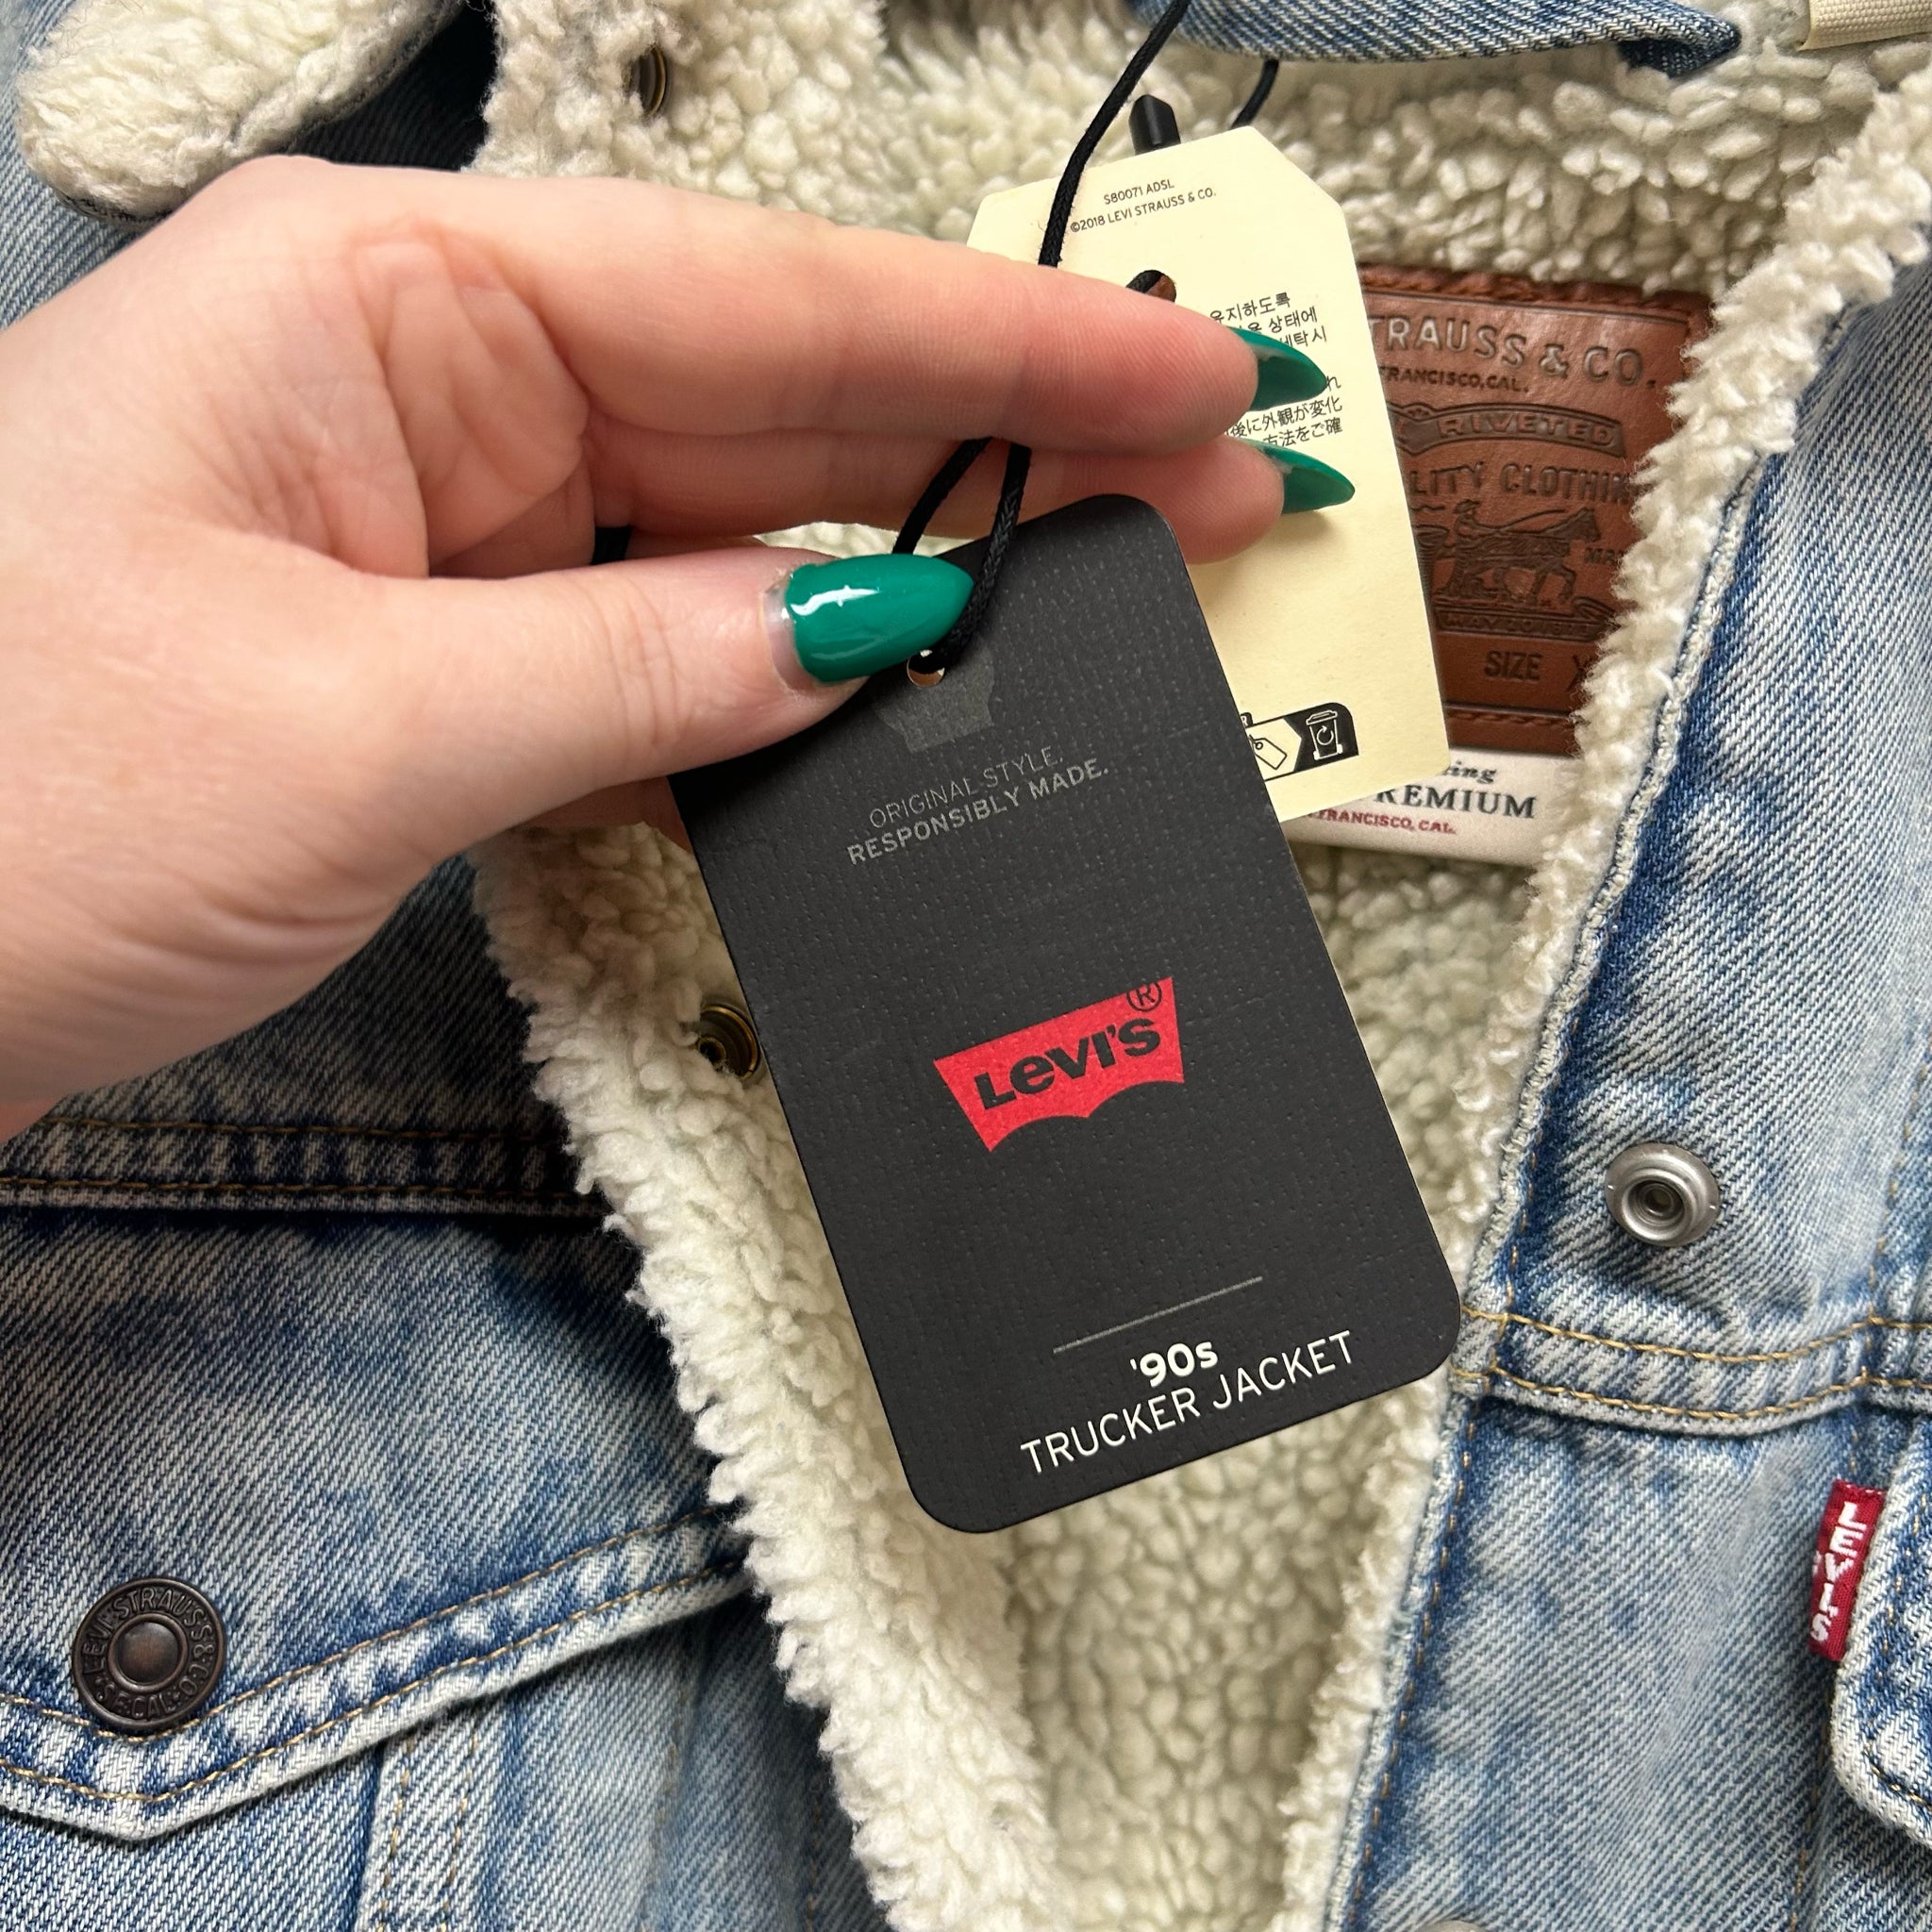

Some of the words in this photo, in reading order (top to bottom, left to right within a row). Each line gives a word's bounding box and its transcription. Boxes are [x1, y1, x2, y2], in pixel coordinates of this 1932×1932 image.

[1104, 186, 1143, 205] S80071
[1146, 178, 1174, 195] ADSL
[1108, 208, 1133, 224] LEVI
[1135, 194, 1185, 216] STRAUSS
[1188, 192, 1195, 203] &
[1197, 187, 1217, 200] CO.
[1269, 306, 1318, 333] 상태에
[1367, 313, 1527, 369] TRAUSS
[1539, 343, 1569, 379] &
[1584, 345, 1656, 391] CO.
[1226, 396, 1342, 438] 後に外観が変化
[1437, 411, 1617, 446] RIVETED
[1500, 460, 1630, 504] CLOTHIN
[1484, 650, 1544, 681] SIZE
[869, 777, 979, 828] ORIGINAL
[982, 746, 1064, 789] STYLE.
[1373, 785, 1539, 820] REMIUM
[846, 786, 1021, 866] RESPONSIBLY
[1027, 758, 1109, 800] MADE.
[1129, 1341, 1219, 1388] '90s
[1020, 1387, 1202, 1474] TRUCKER
[1212, 1329, 1353, 1410] JACKET
[1810, 1501, 1867, 1641] LEVI'S
